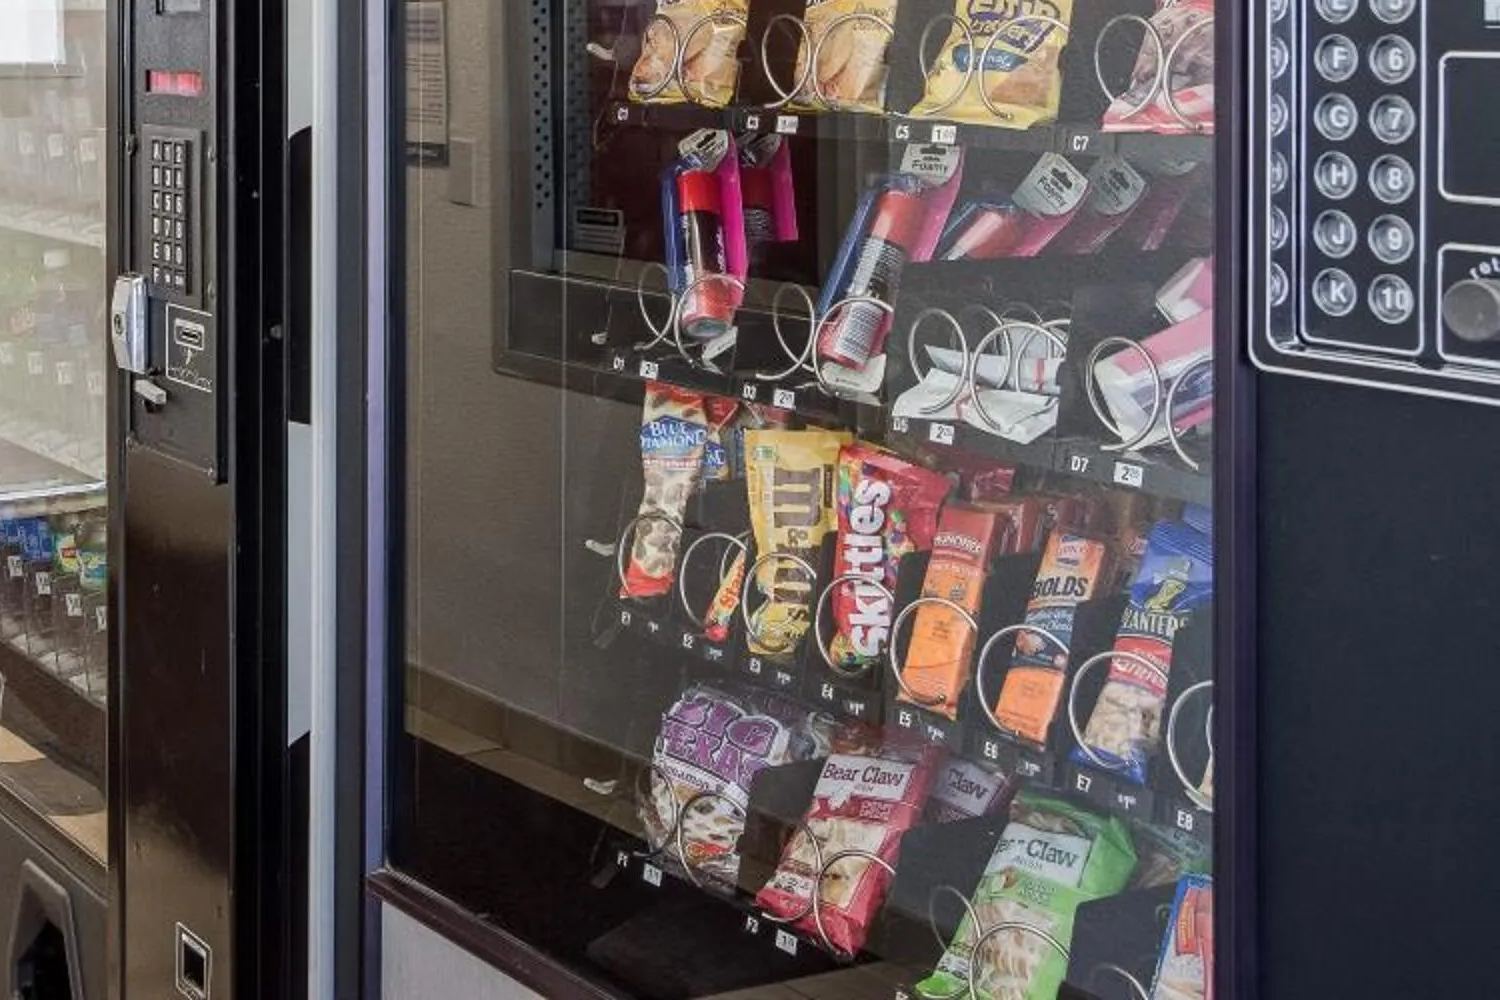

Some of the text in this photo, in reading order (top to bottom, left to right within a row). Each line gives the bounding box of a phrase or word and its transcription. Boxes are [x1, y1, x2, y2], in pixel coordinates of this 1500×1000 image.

[1331, 47, 1403, 71] F 6
[1330, 106, 1403, 131] G 7
[896, 124, 909, 140] C5
[1073, 135, 1089, 151] C7
[1331, 164, 1403, 191] H 8
[1332, 223, 1402, 251] J 9
[1330, 281, 1408, 311] K 10
[650, 421, 687, 438] BLUE
[1071, 455, 1089, 473] D7
[822, 763, 904, 786] Bear Claw
[949, 768, 990, 799] Claw
[1076, 773, 1092, 792] E7
[1026, 838, 1079, 868] Claw
